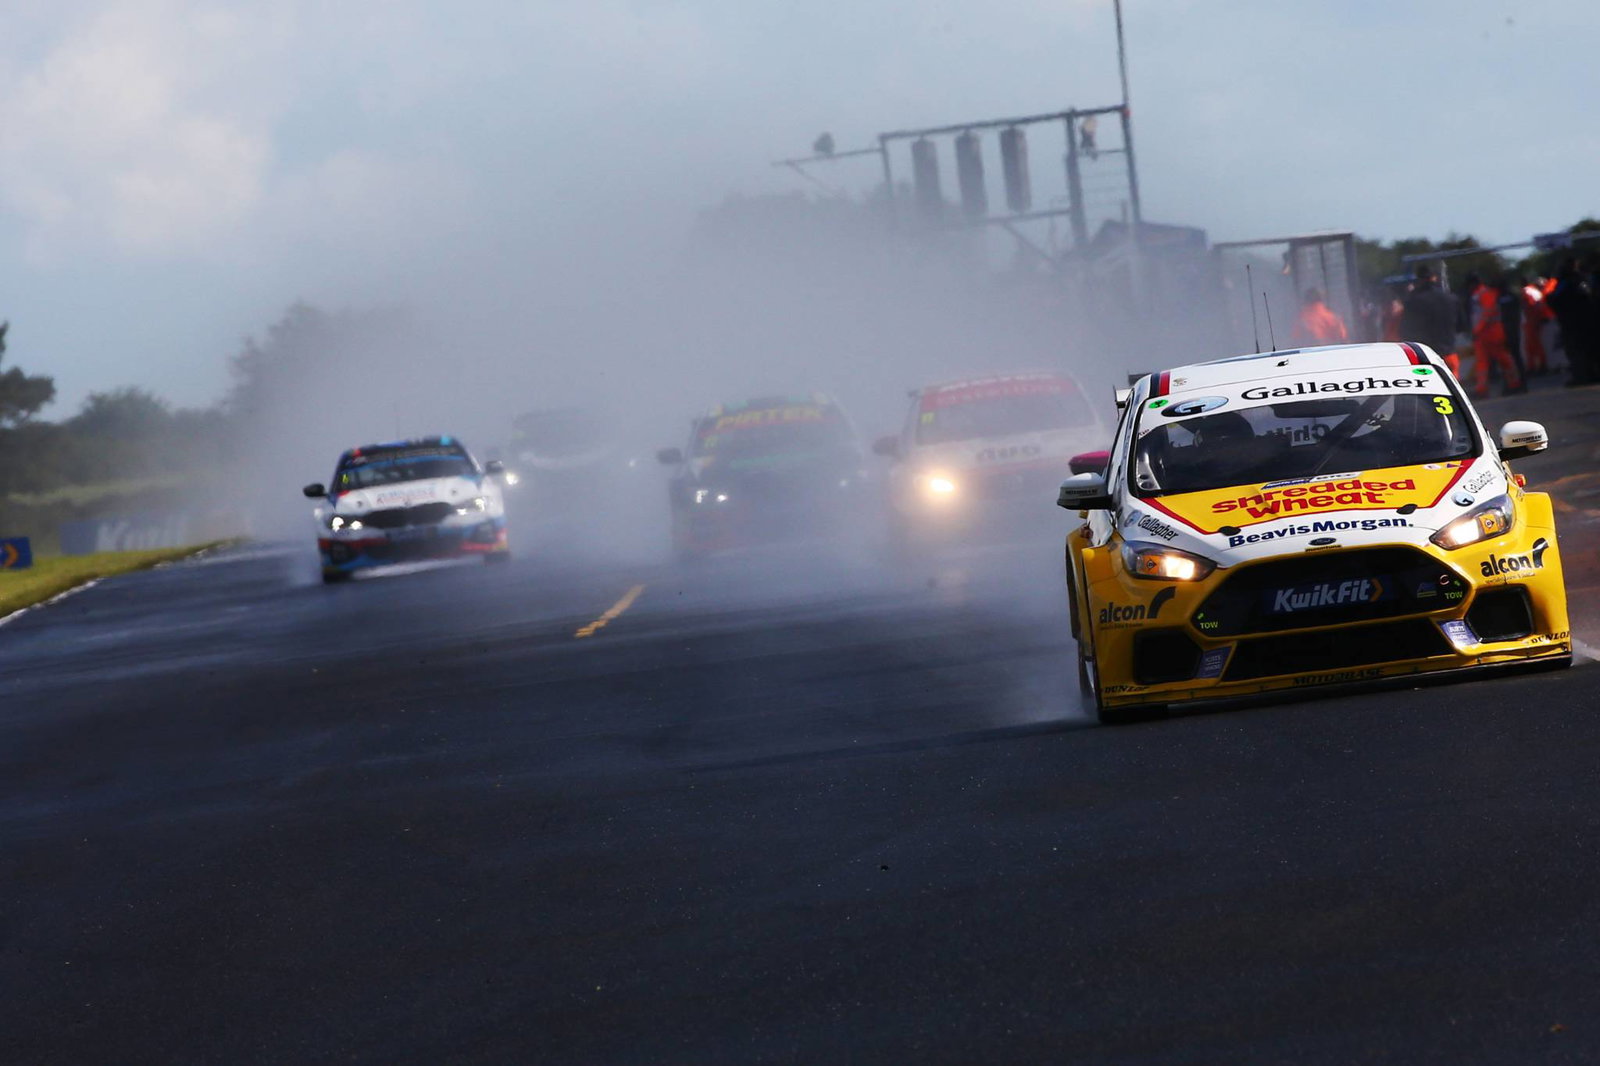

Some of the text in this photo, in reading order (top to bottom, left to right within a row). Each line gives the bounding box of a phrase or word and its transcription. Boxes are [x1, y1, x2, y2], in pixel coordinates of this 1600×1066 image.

[1241, 377, 1429, 400] Gallagher
[1433, 396, 1454, 415] 3
[1212, 479, 1416, 514] shredded
[1246, 491, 1385, 518] wheat
[1138, 515, 1179, 541] Gallagher
[1480, 554, 1531, 577] alcon
[1445, 592, 1463, 600] TOW
[1100, 602, 1146, 624] alcon
[1200, 621, 1219, 629] TOW
